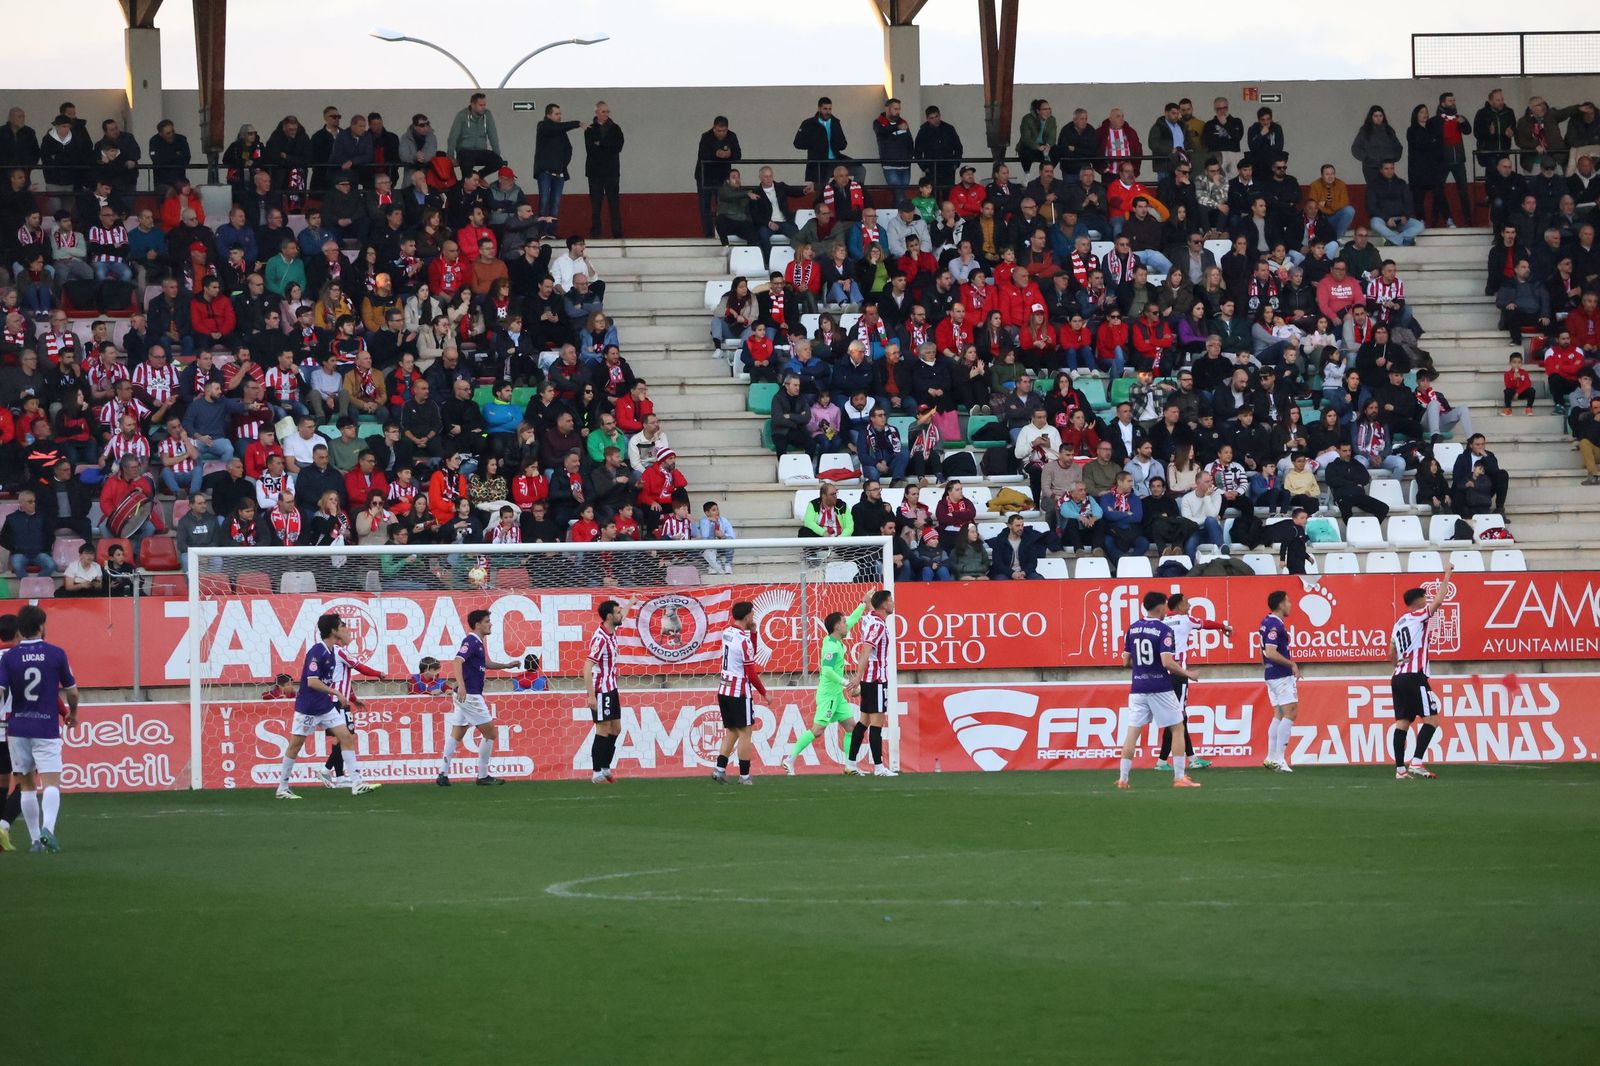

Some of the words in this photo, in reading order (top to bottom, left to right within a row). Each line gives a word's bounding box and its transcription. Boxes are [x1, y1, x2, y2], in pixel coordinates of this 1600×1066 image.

[1483, 580, 1600, 628] ZAM
[164, 597, 469, 680] ZAMORA
[486, 594, 592, 673] CF
[918, 605, 1047, 638] ÓPTICO
[22, 654, 46, 662] LUCAS
[648, 642, 700, 658] MODORRO
[1133, 638, 1154, 666] 19
[1327, 647, 1387, 657] BIOMECÁNICA
[24, 667, 42, 701] 2
[605, 696, 610, 707] 2
[60, 714, 175, 748] uela
[1290, 721, 1565, 765] ZAMORANAS
